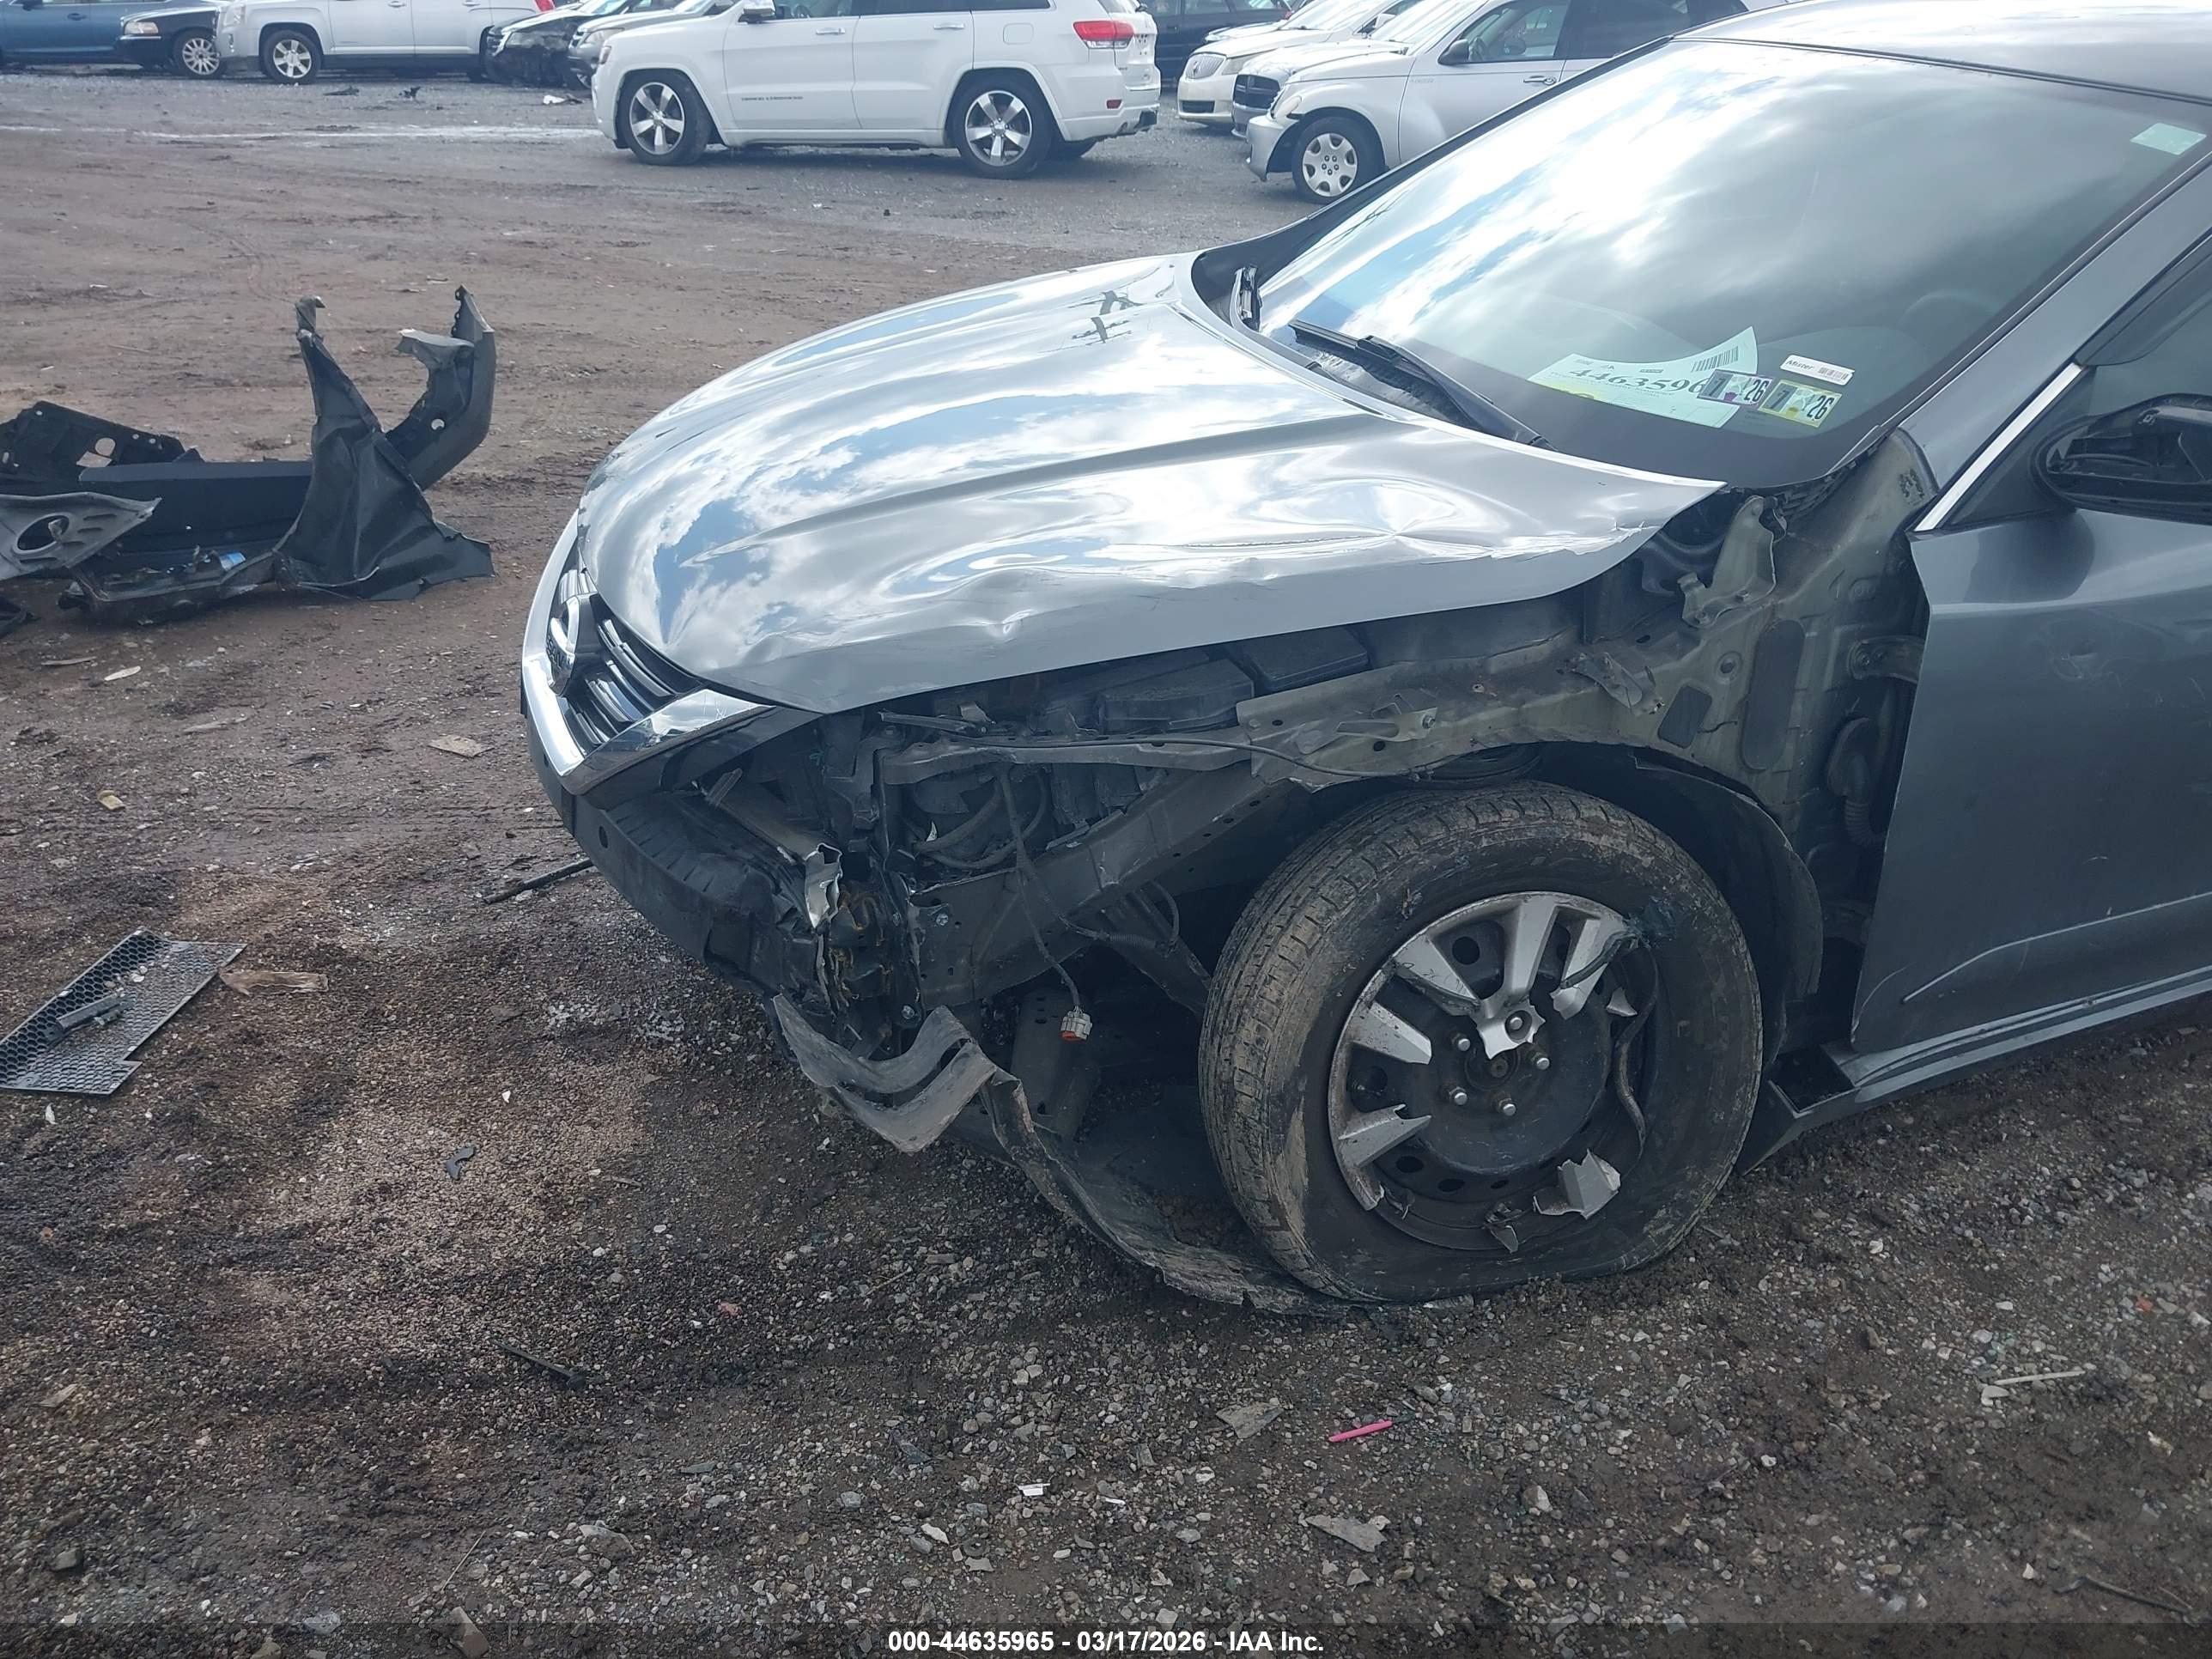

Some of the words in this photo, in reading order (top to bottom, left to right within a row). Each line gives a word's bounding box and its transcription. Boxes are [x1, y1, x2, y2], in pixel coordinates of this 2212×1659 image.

[1568, 369, 1710, 393] 4463596
[1709, 378, 1725, 397] 7
[1744, 380, 1770, 403] 26
[1769, 389, 1790, 410] 7
[1806, 394, 1835, 420] 26
